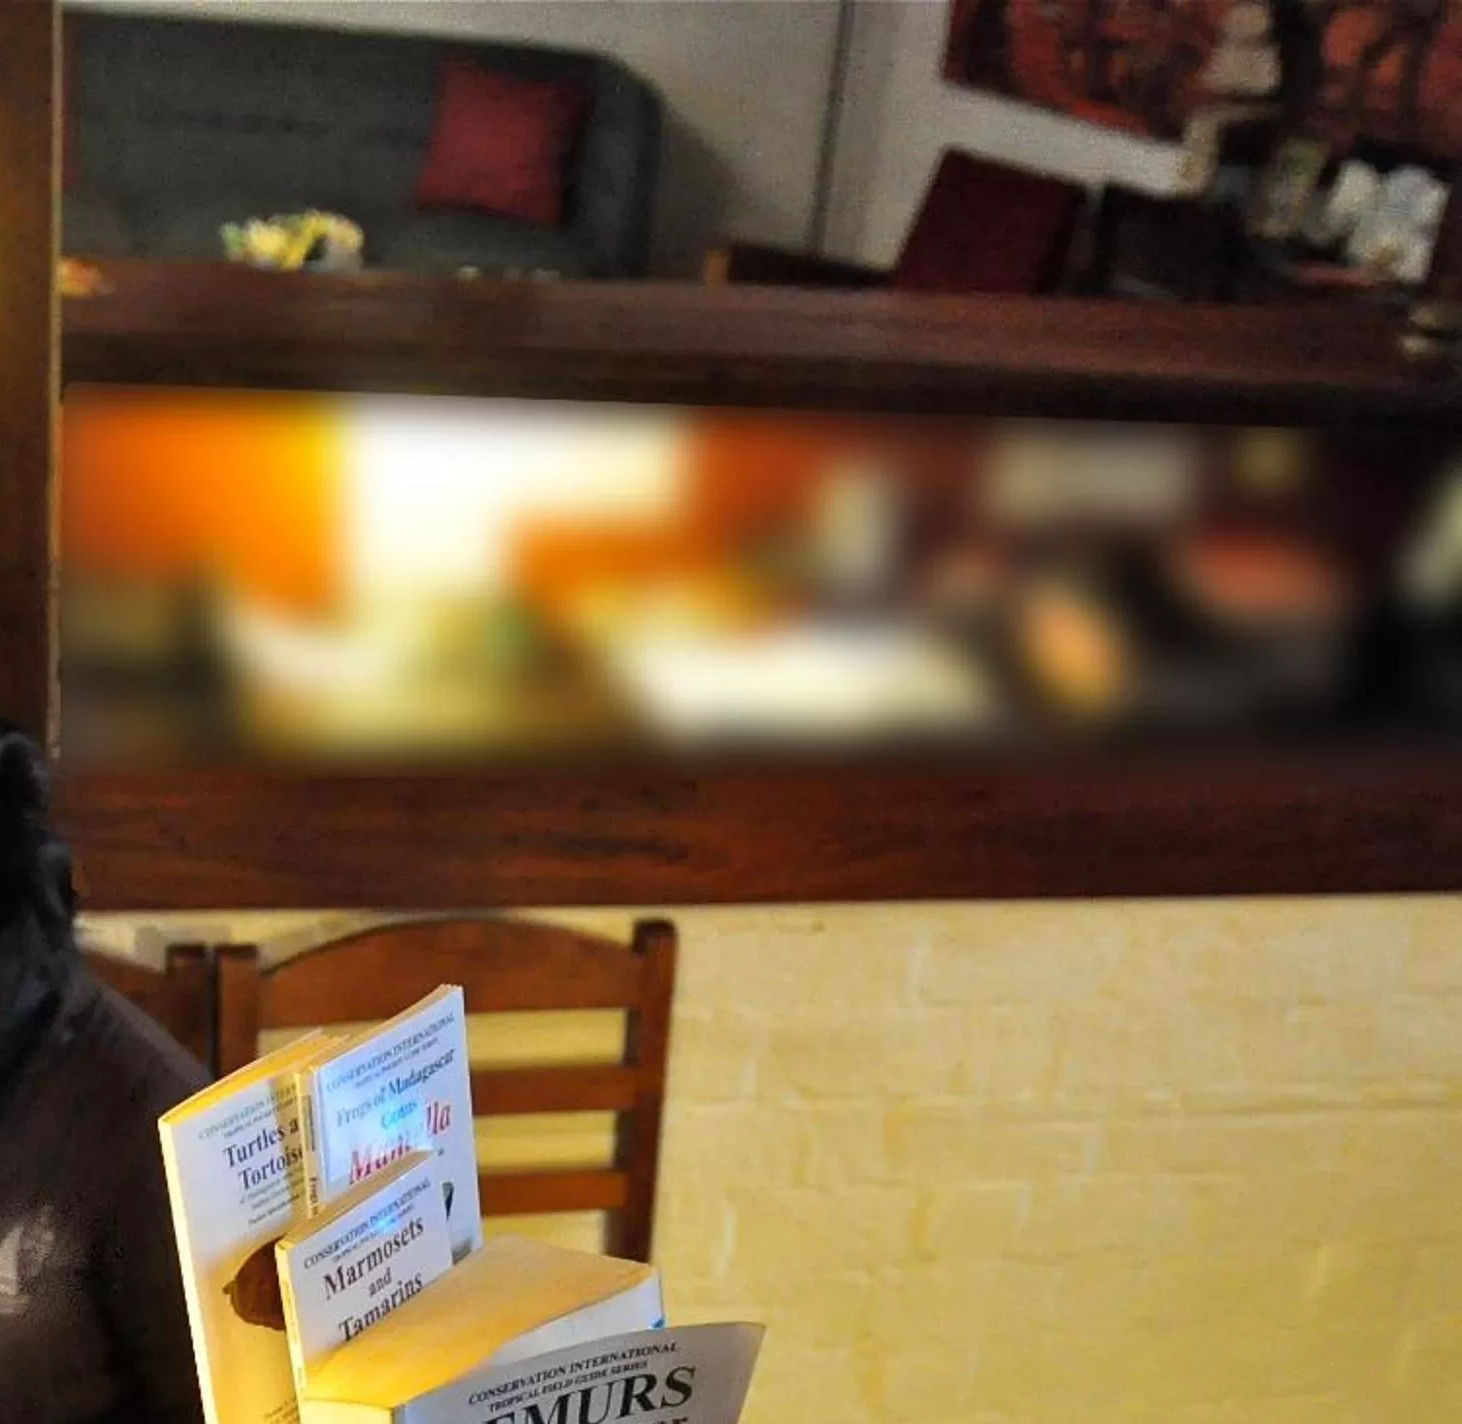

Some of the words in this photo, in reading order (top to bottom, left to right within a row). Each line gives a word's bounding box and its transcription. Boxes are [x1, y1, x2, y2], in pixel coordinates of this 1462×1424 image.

[388, 1048, 455, 1095] Madagascar
[222, 1127, 286, 1168] Turtles
[238, 1145, 303, 1190] Tortois
[323, 1216, 425, 1300] Marmosets
[369, 1266, 393, 1297] and
[338, 1272, 424, 1342] Tamarins
[469, 1365, 567, 1404] CONSERVATION
[570, 1341, 678, 1374] INTERNATIONAL
[489, 1387, 539, 1413] TROPICAL
[541, 1377, 573, 1396] FIELD
